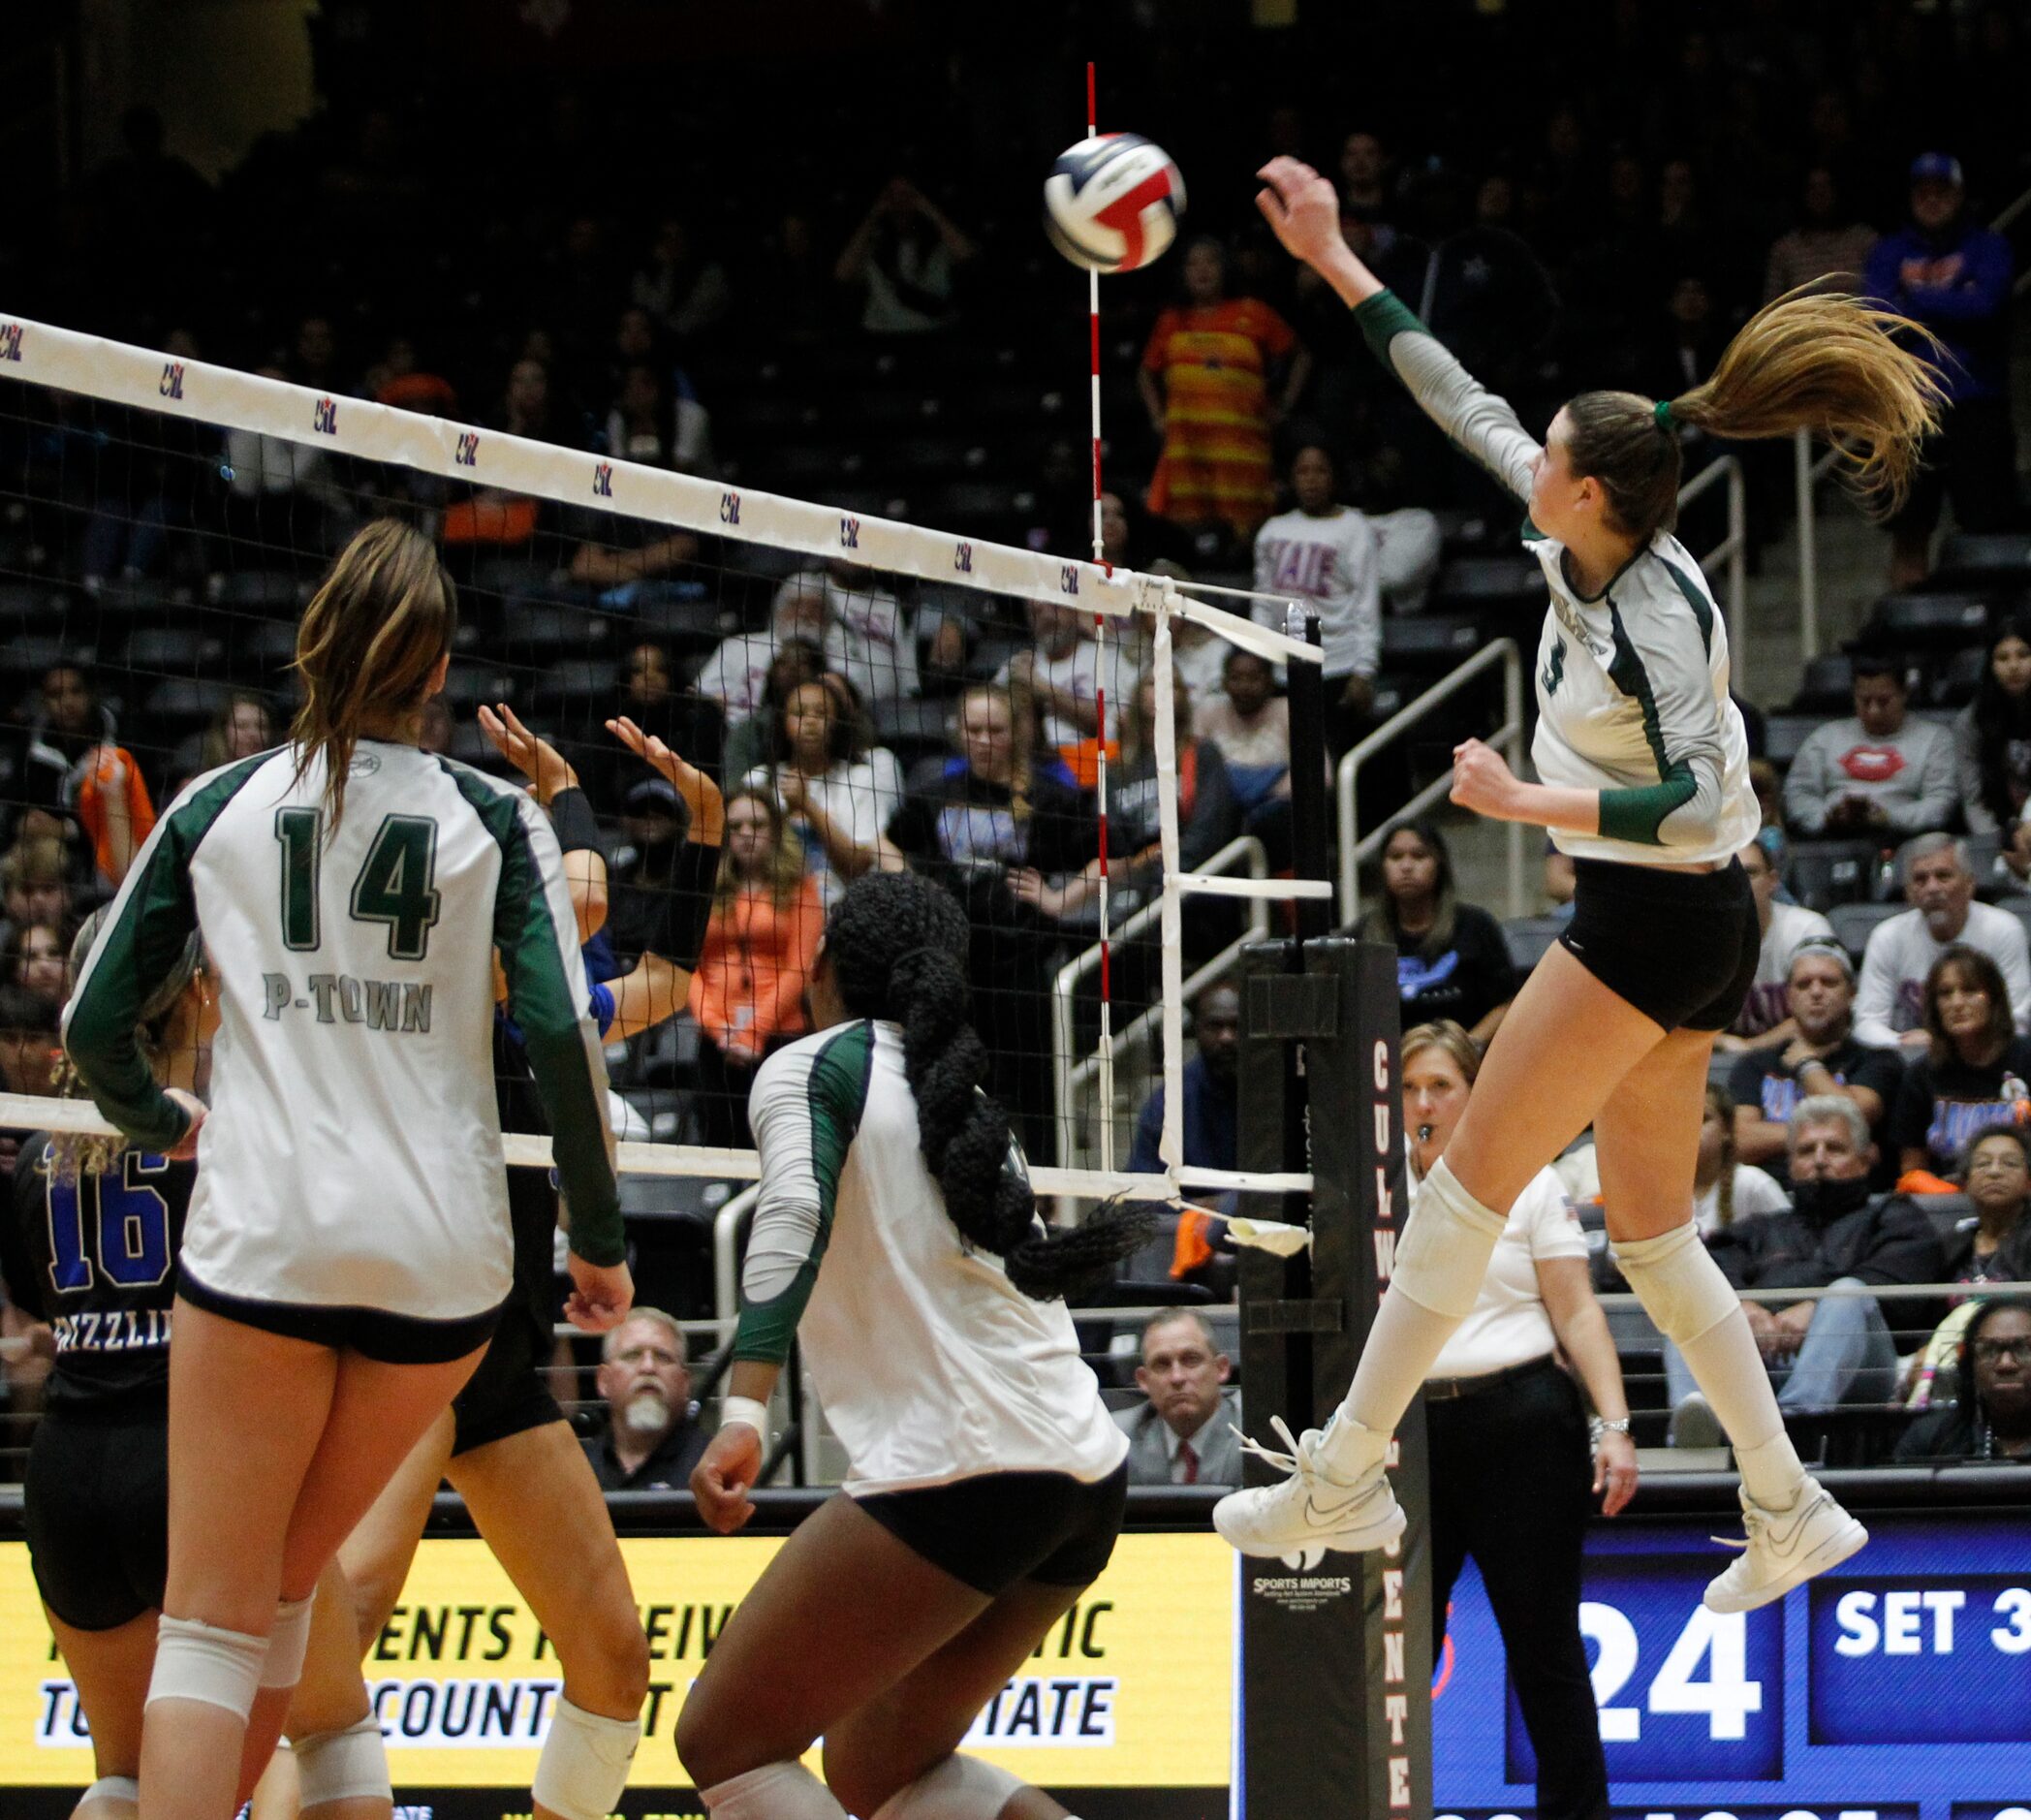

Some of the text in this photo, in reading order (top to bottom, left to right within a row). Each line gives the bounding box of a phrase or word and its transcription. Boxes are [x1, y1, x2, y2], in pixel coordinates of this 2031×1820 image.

[274, 805, 442, 961] 14
[262, 972, 433, 1034] P-TOWN
[43, 1142, 172, 1294] 16
[1253, 1577, 1351, 1593] SPORTS IMPORTS
[374, 1605, 516, 1660] ENTS
[1058, 1602, 1113, 1658] IC
[1834, 1587, 2031, 1658] SET 3
[1578, 1602, 1763, 1742] 24
[374, 1683, 556, 1737] COUNT
[647, 1682, 673, 1736] T
[984, 1680, 1113, 1736] TATE
